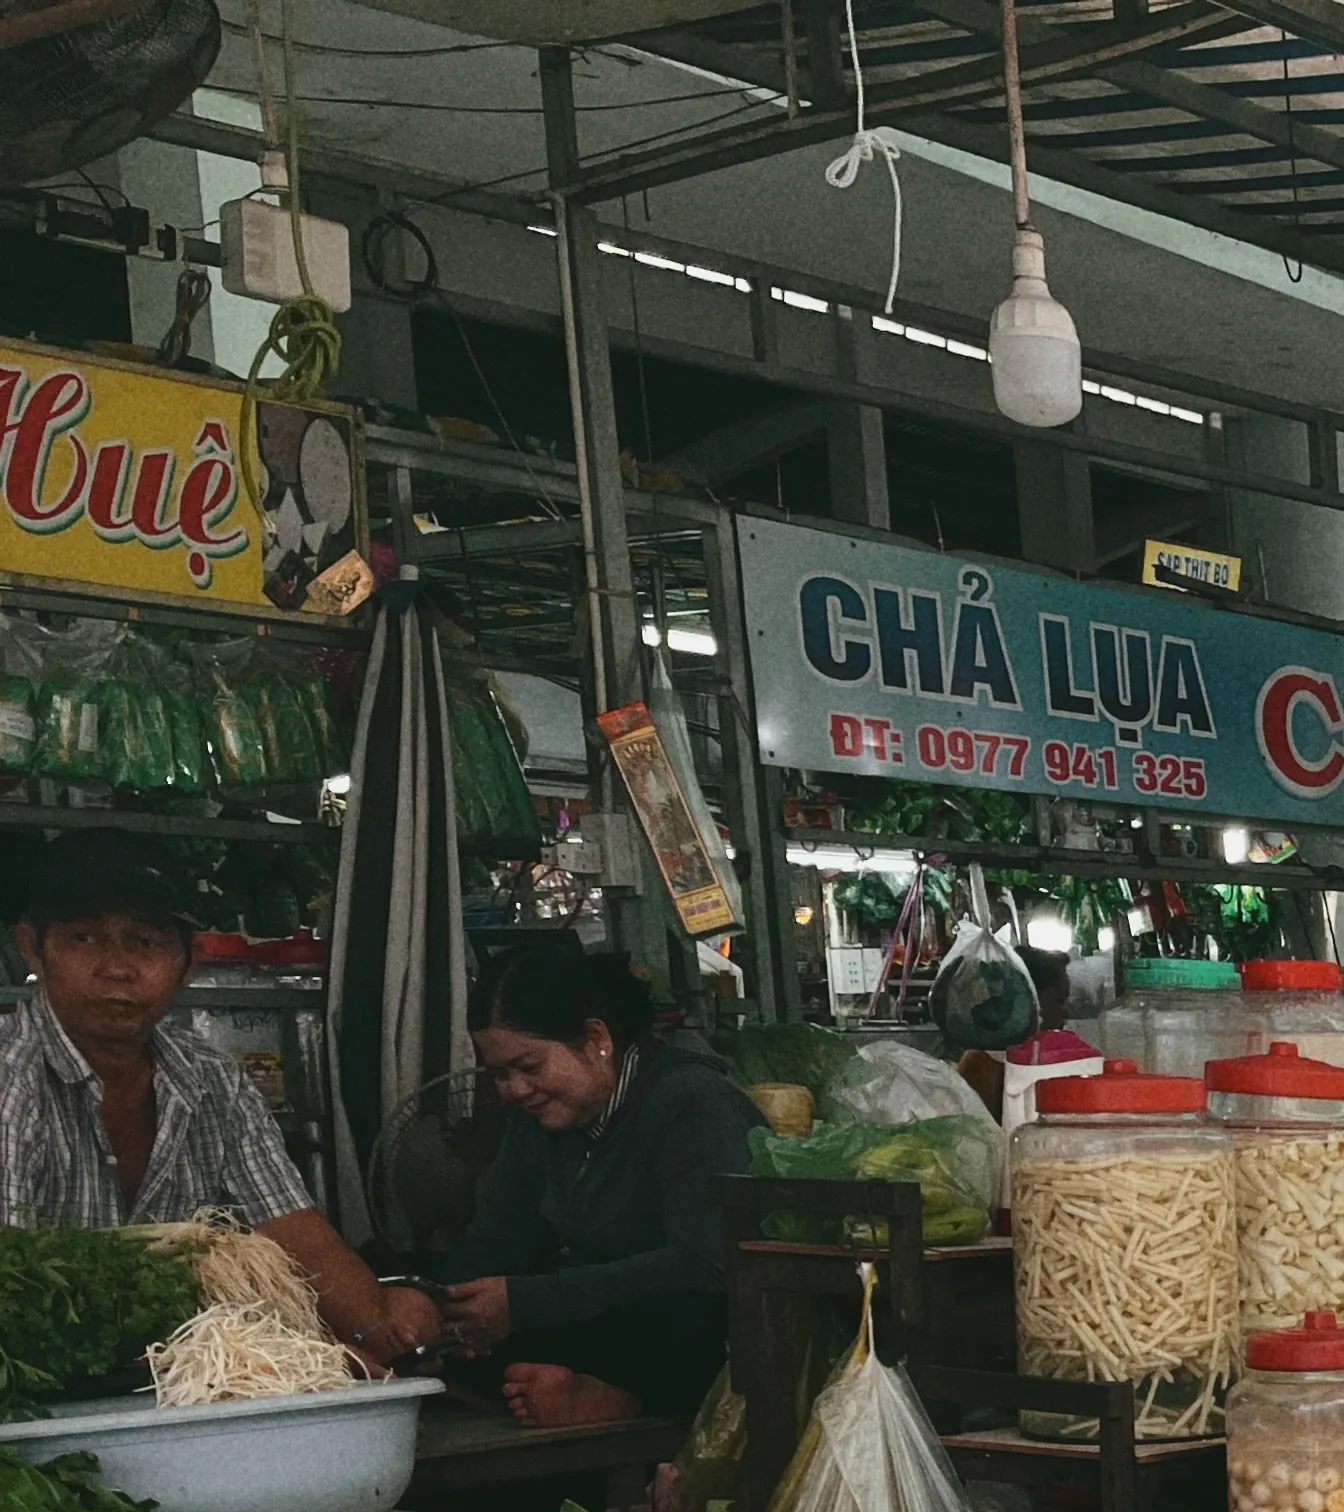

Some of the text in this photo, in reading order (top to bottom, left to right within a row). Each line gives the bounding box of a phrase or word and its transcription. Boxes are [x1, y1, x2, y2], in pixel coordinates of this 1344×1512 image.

[799, 570, 1214, 744] CHẢ LỤA
[829, 713, 1207, 798] ĐT: 0977 941 325
